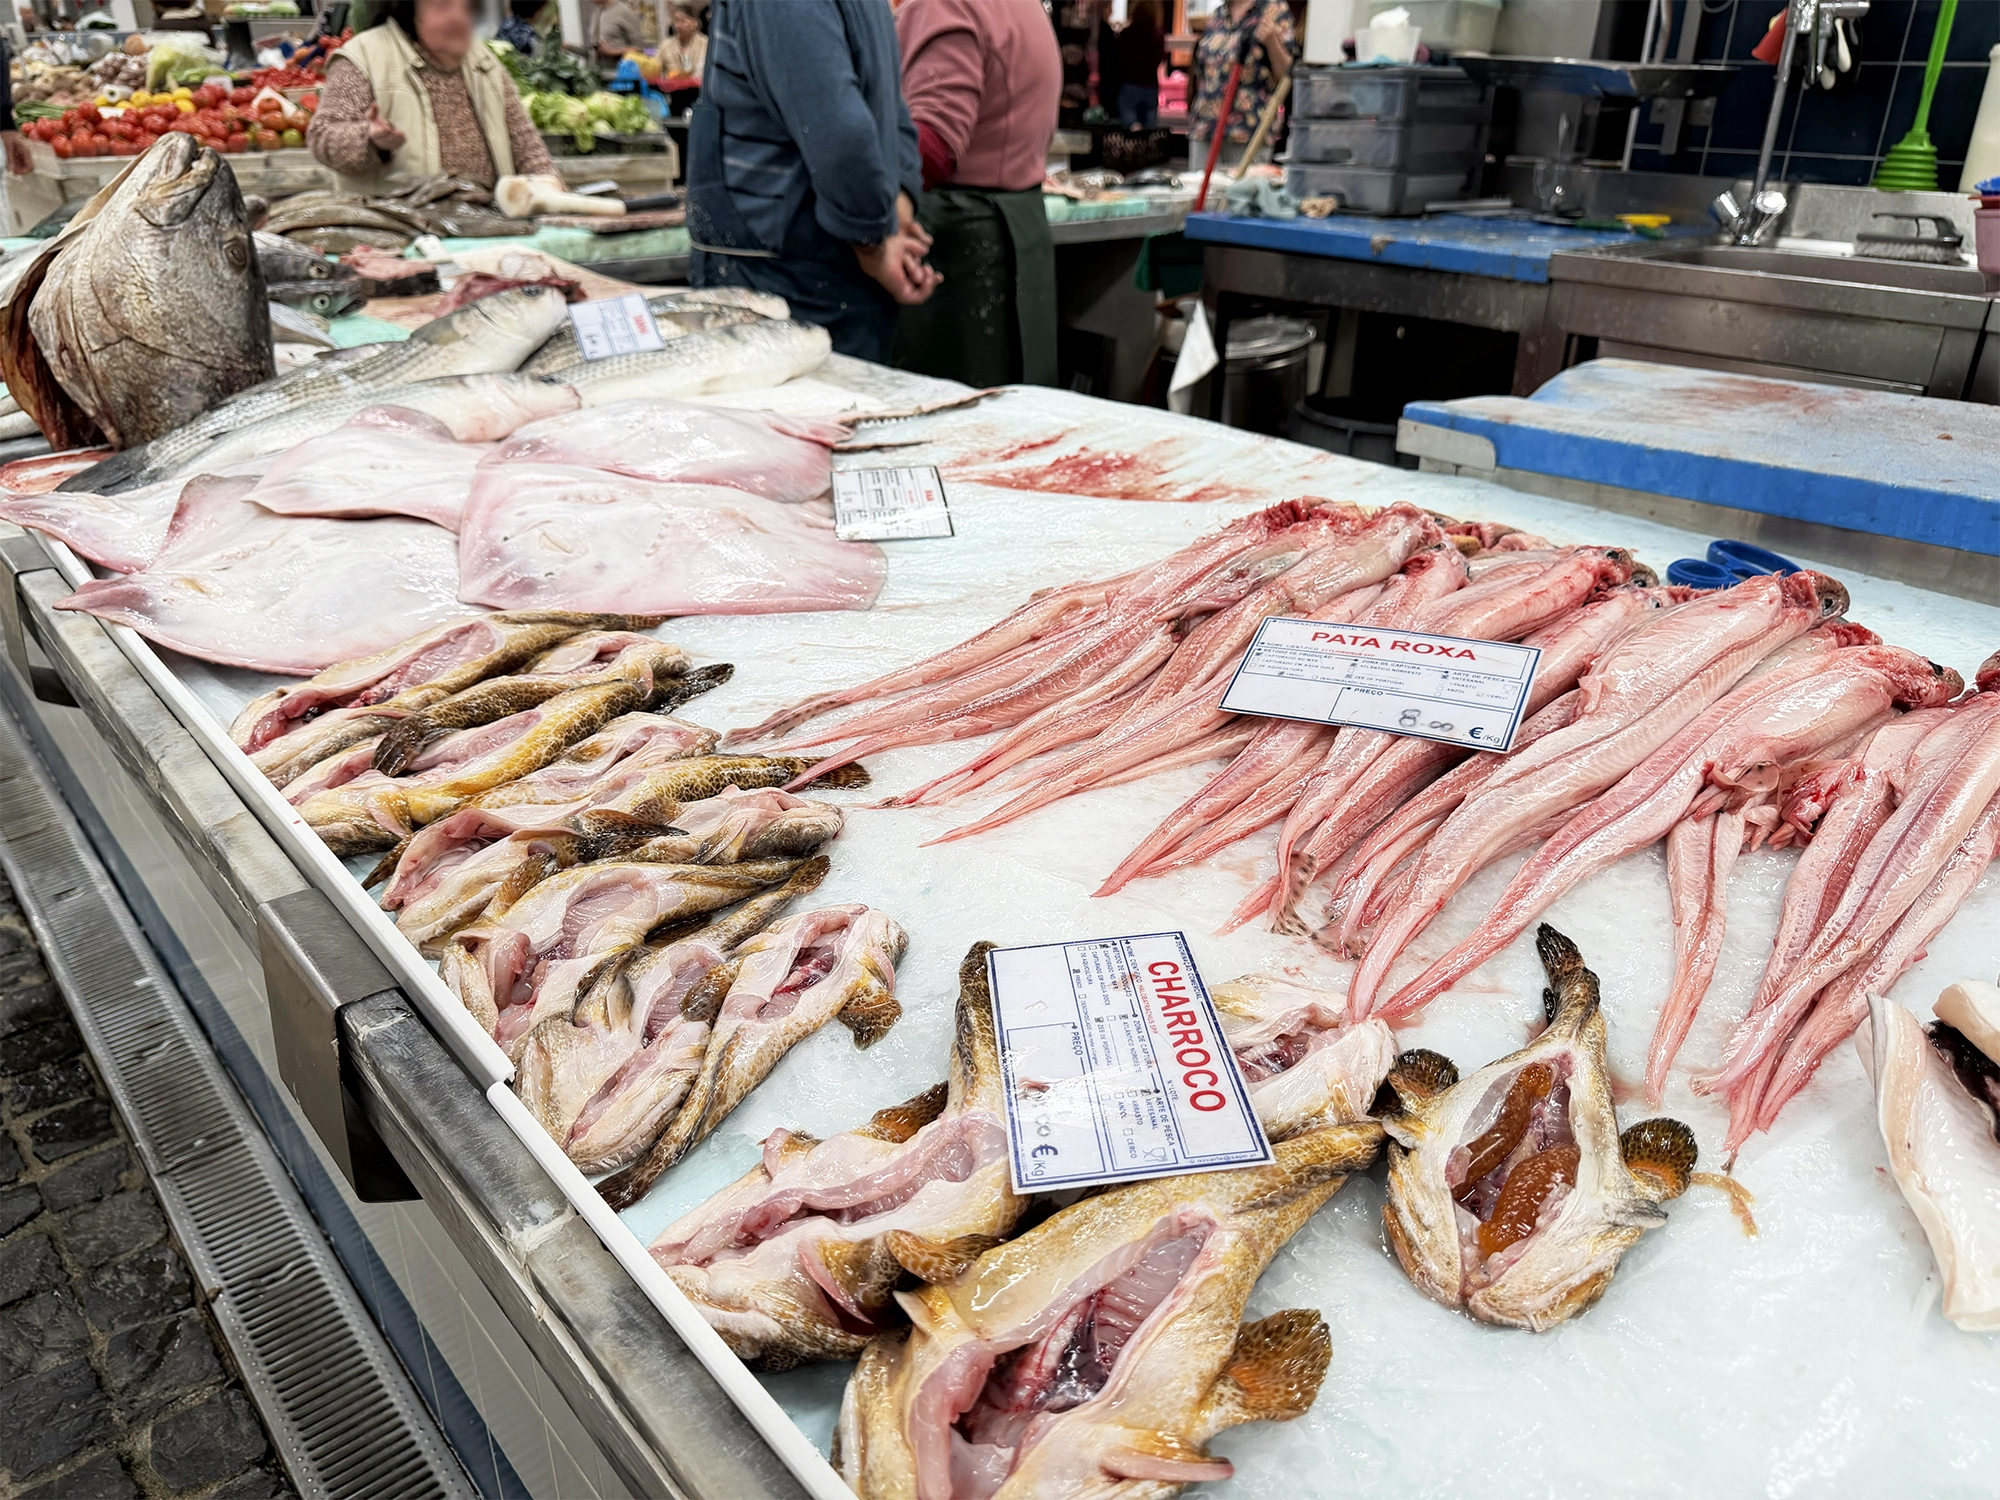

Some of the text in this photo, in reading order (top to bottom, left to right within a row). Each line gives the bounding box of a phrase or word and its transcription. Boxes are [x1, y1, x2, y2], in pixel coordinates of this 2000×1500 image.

[1311, 632, 1476, 660] PATA ROXA
[1354, 688, 1383, 696] PREÇO
[1103, 950, 1114, 973] CAPTURADO
[1126, 946, 1135, 957] NOME
[1092, 951, 1102, 974] CAPTURADO
[1103, 994, 1111, 1006] DOCE
[1188, 973, 1202, 1000] COMERCIAL
[1071, 1031, 1083, 1055] PREÇO
[1133, 1020, 1143, 1034] ZONA
[1140, 1044, 1153, 1069] CAPTURA
[1148, 961, 1226, 1112] CHARROCO
[1102, 1041, 1112, 1066] PORTUGAL
[1132, 1100, 1143, 1125] ARRASTO
[1146, 1099, 1158, 1130] ARTESANAL
[1156, 1097, 1175, 1146] ARTE DE PESCA
[1126, 1138, 1137, 1159] CERCO
